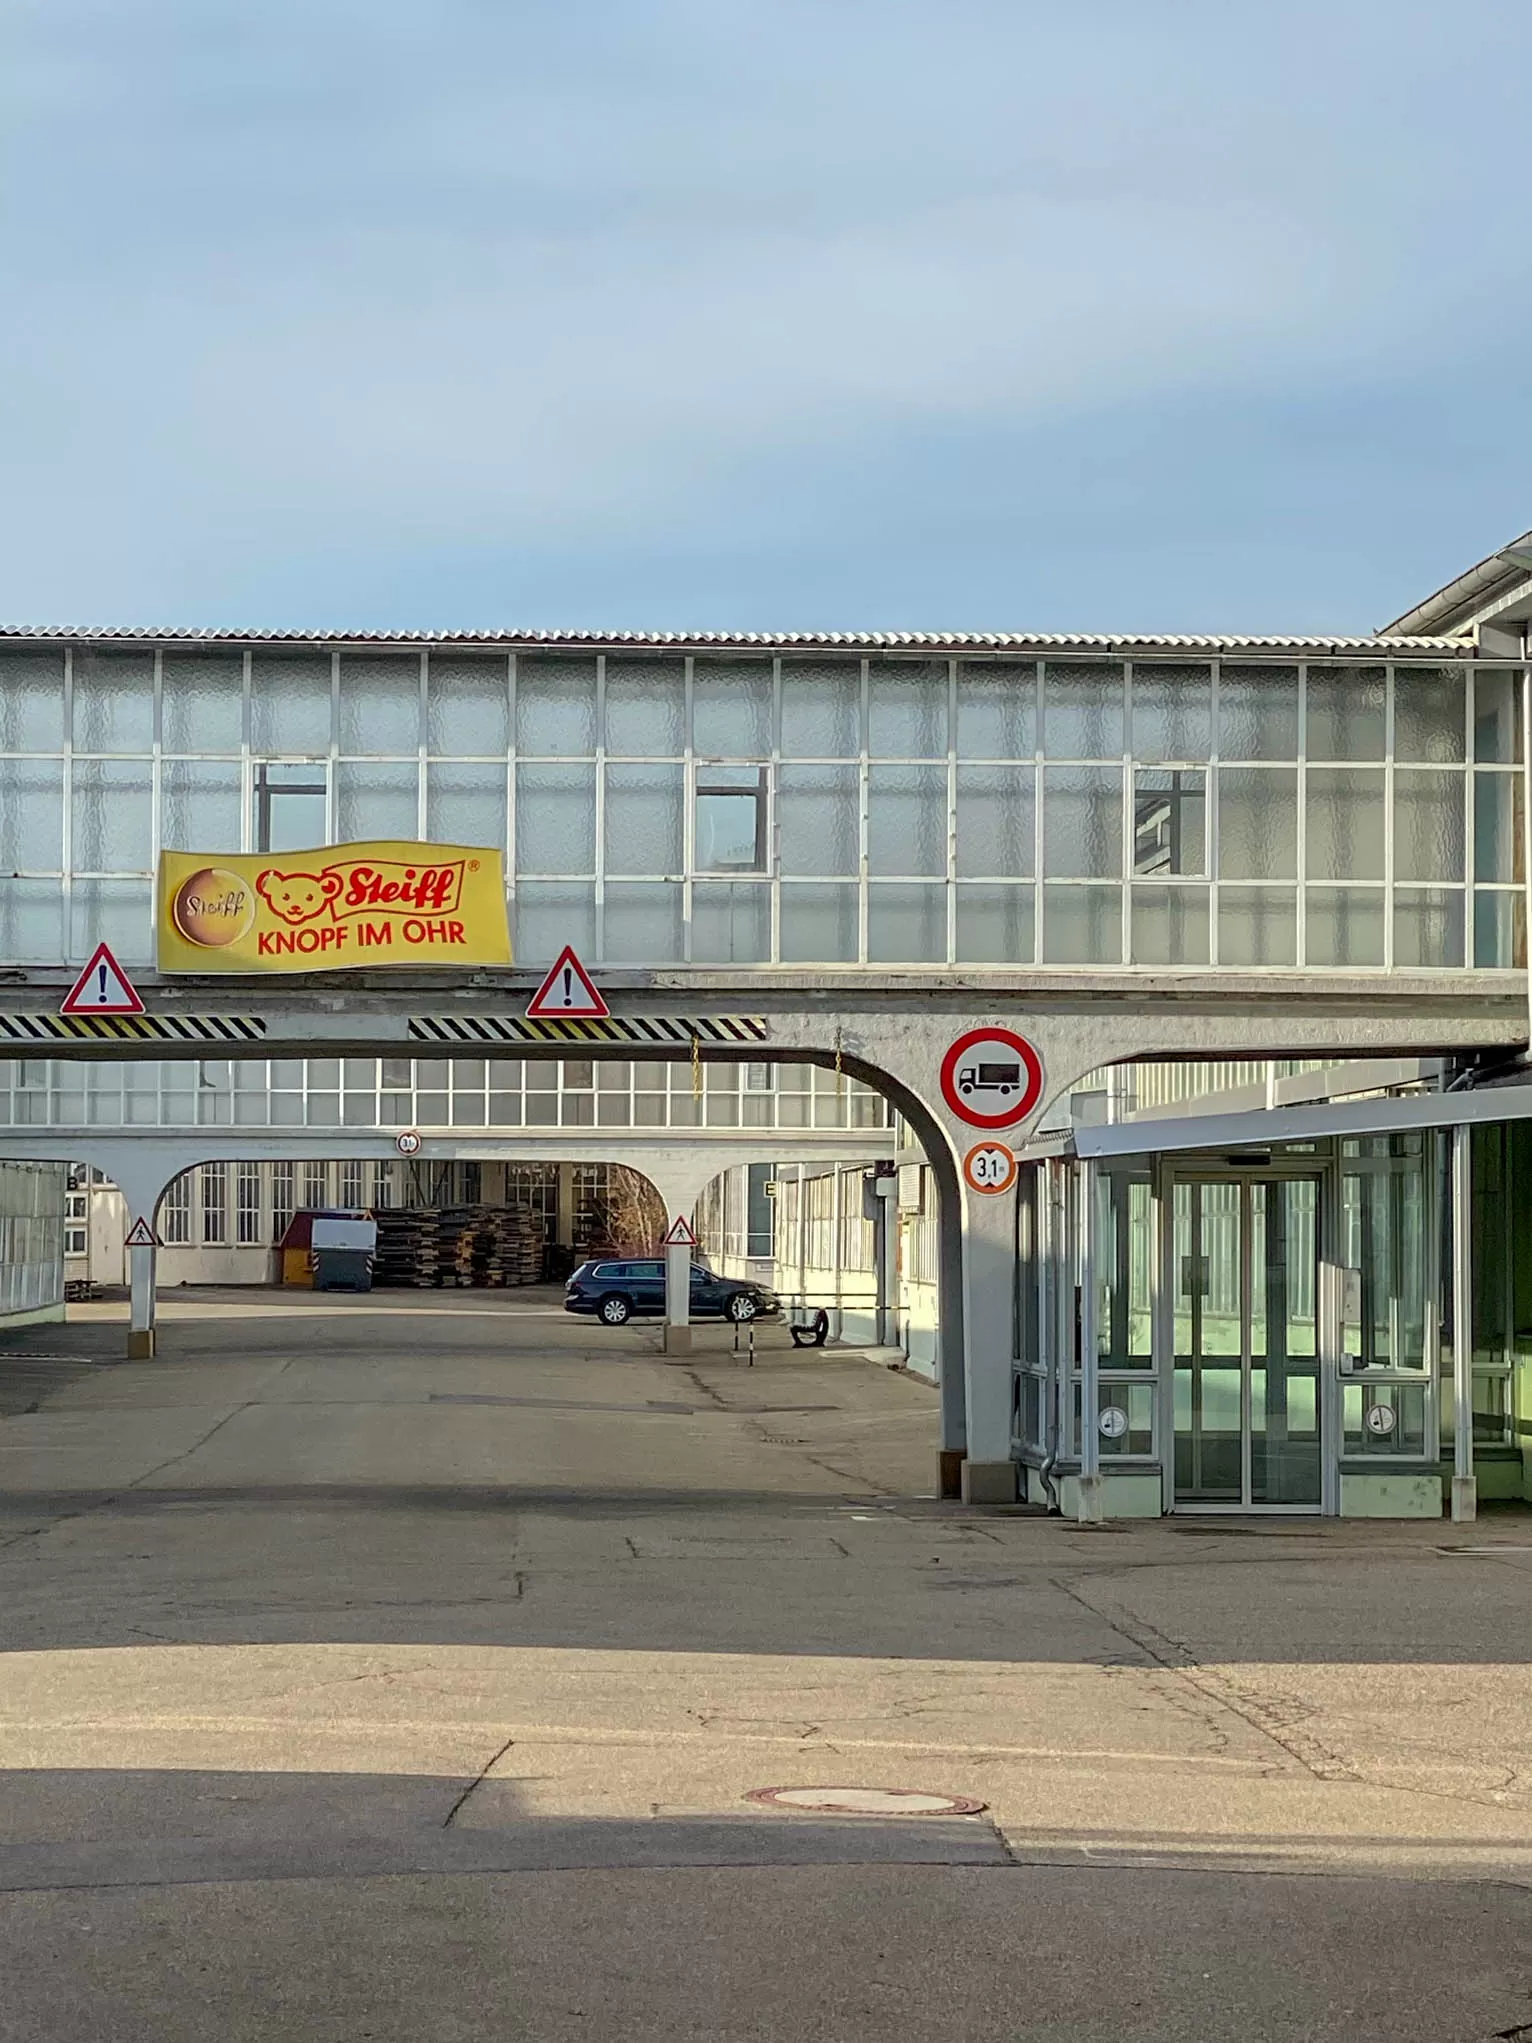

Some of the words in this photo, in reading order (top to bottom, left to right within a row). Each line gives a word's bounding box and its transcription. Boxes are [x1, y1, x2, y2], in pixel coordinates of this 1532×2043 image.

[187, 891, 245, 917] Steiff
[348, 868, 454, 909] Steiff
[258, 926, 348, 955] KNOPF
[357, 922, 392, 945] IM
[402, 919, 467, 945] OHR
[66, 1176, 78, 1191] B
